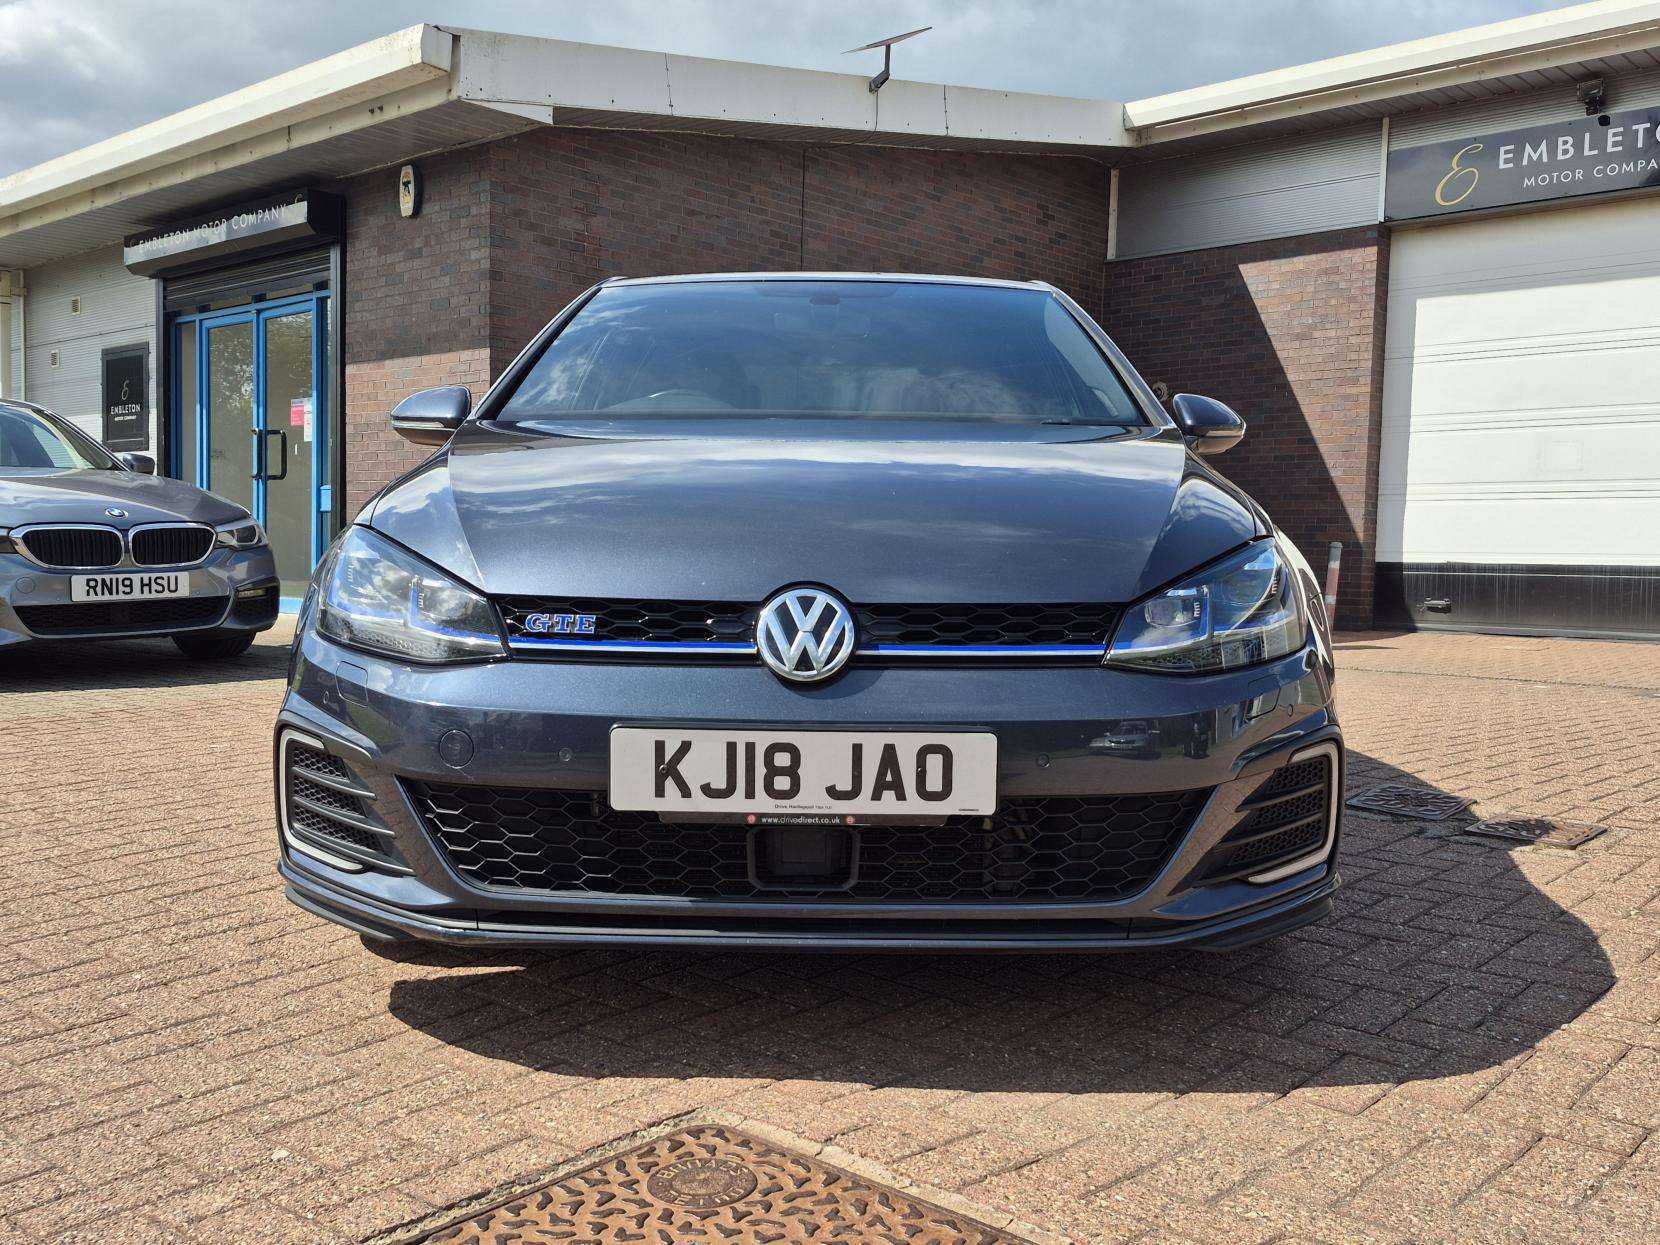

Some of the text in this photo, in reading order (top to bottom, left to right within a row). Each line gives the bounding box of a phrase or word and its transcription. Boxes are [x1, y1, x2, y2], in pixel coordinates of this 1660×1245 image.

[1499, 123, 1660, 169] EMBLET
[1523, 158, 1658, 188] MOTOR COMPA
[139, 204, 287, 251] EMBLETON MOTOR COMPANY
[110, 403, 141, 415] EMBLETON
[86, 575, 179, 596] RN19 HSU
[525, 613, 598, 635] GTE
[654, 740, 954, 801] KJ18 JAO
[761, 815, 841, 825] www.drivedirect.co.uk
